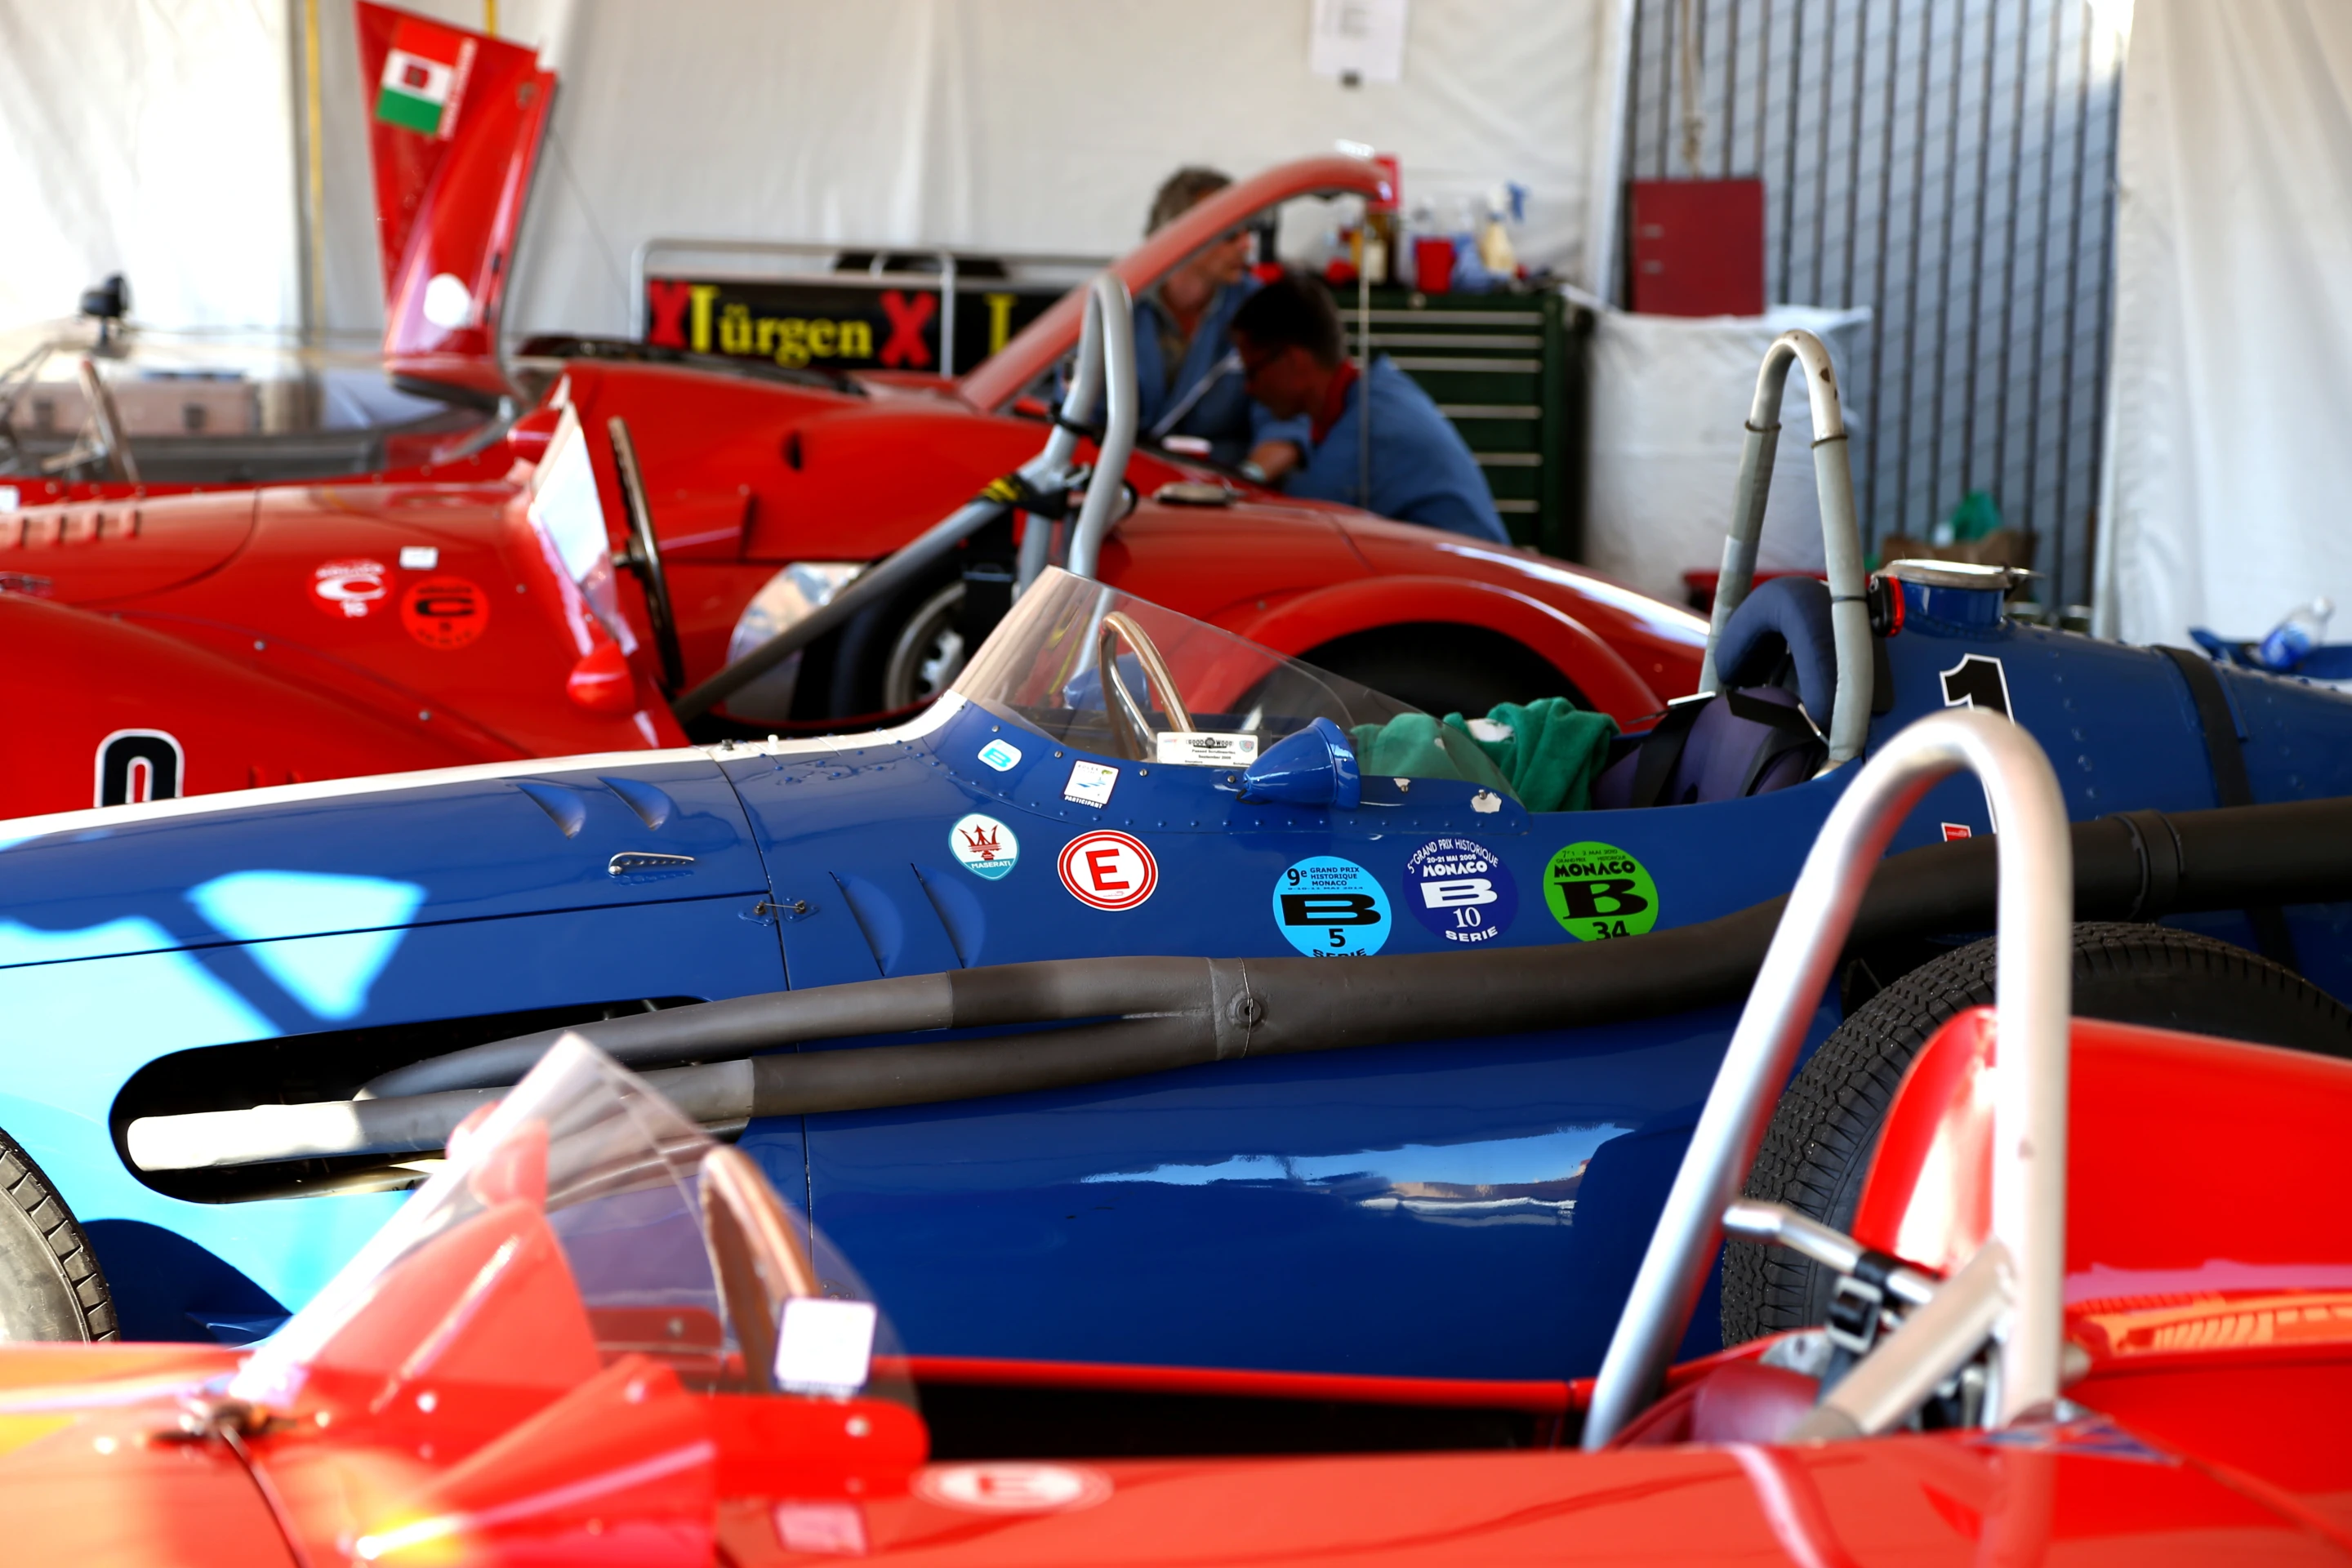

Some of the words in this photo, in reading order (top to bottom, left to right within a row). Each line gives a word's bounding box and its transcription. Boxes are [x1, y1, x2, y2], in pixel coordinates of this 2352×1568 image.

[982, 747, 1012, 768] B
[1064, 794, 1103, 809] PARTICIPANT
[1413, 841, 1437, 864] GRAND
[1438, 839, 1454, 850] PRIX
[1454, 839, 1499, 868] HISTORIQUE
[971, 860, 1011, 869] MASERATI
[1085, 849, 1130, 891] E
[1423, 860, 1488, 877] MONACO
[1553, 861, 1636, 878] MONACO
[1420, 878, 1498, 908] B
[1554, 879, 1648, 920] B
[1281, 893, 1382, 926] B
[1453, 906, 1481, 928] 10
[1328, 929, 1346, 947] 5
[1446, 926, 1498, 942] SERIE
[1592, 920, 1630, 940] 34
